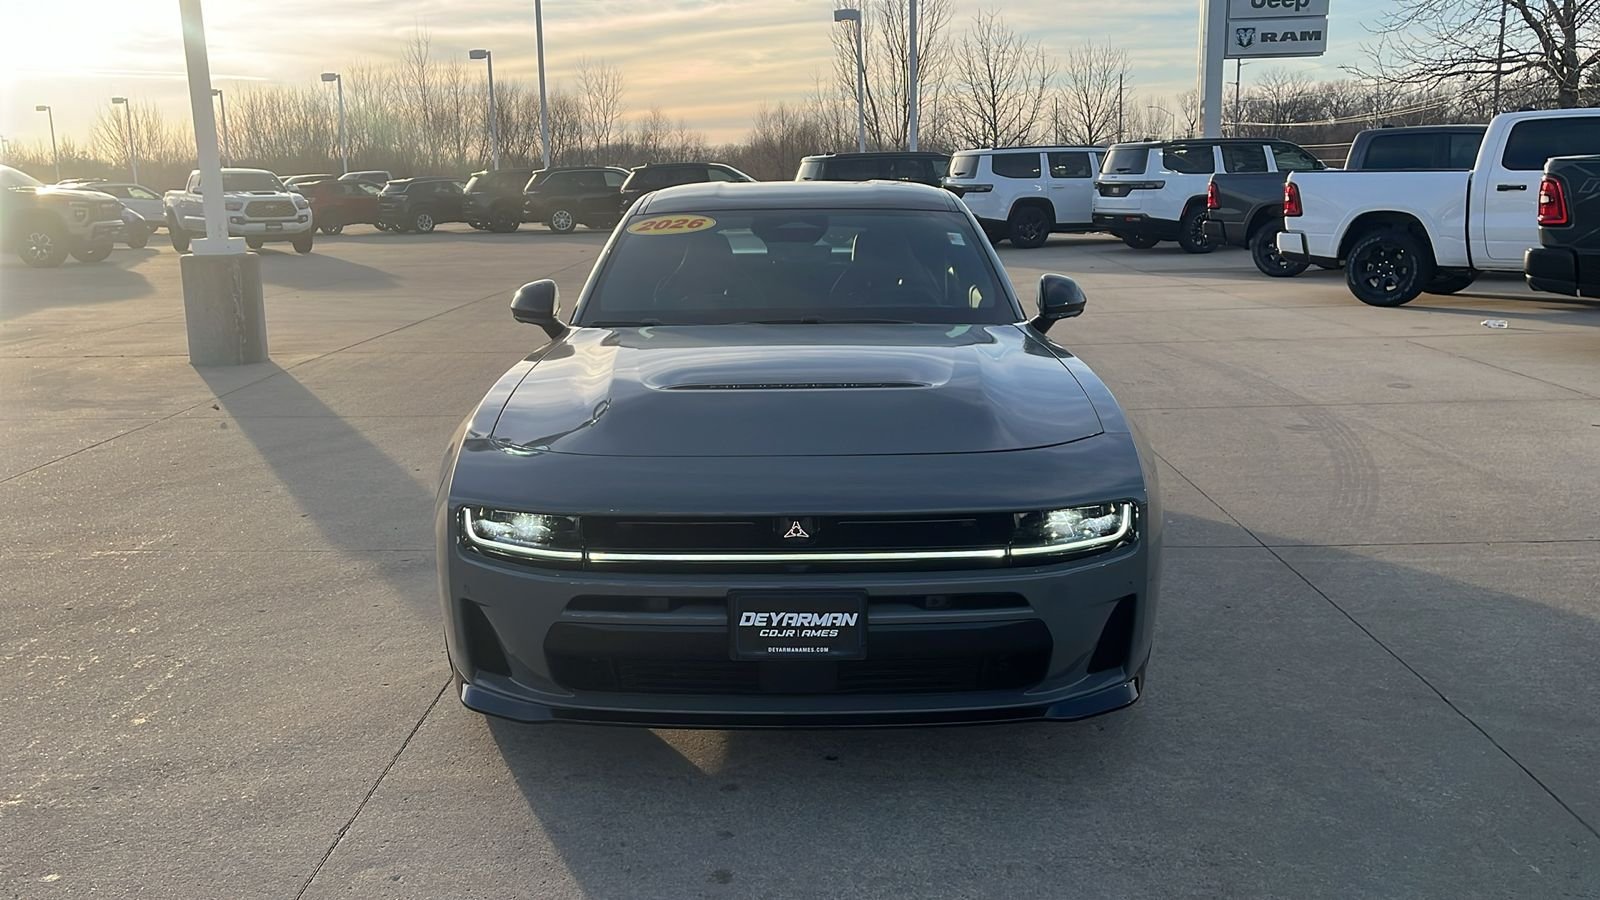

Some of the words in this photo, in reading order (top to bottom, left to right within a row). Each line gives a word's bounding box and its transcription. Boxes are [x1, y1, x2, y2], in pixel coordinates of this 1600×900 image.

[1260, 30, 1322, 42] RAM
[635, 218, 706, 231] 2026
[739, 611, 858, 627] DEYARMAN
[759, 629, 795, 637] CDJR
[801, 629, 839, 637] AMES
